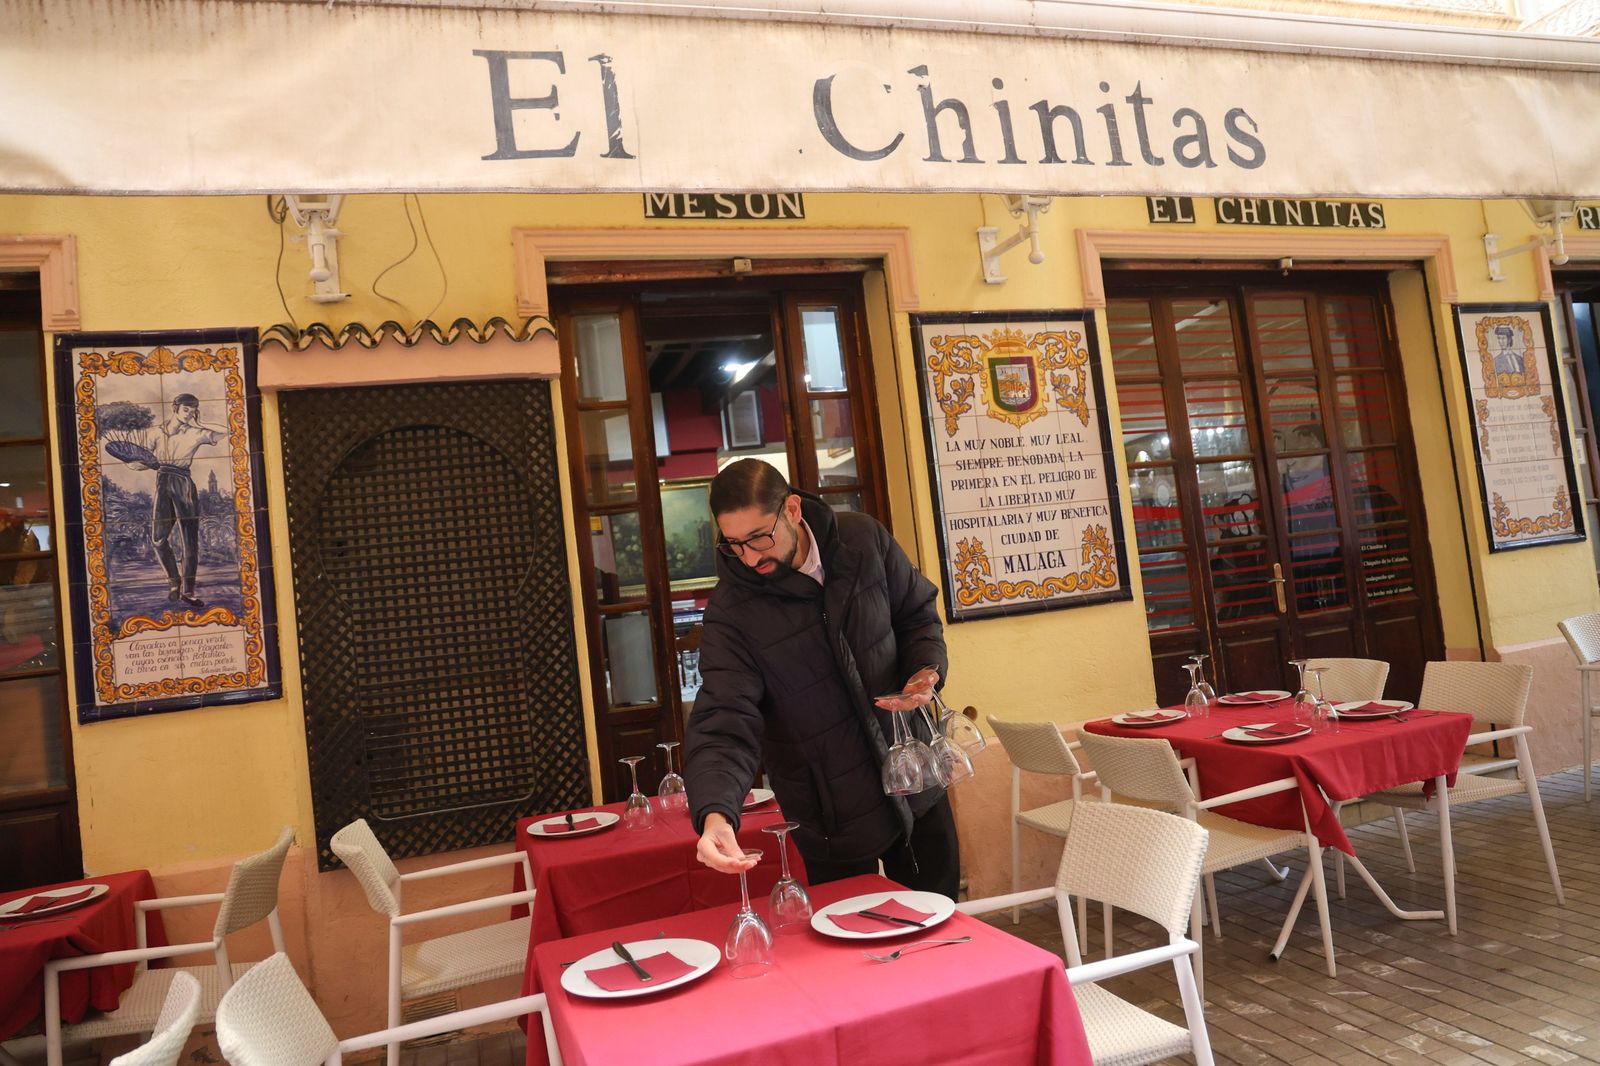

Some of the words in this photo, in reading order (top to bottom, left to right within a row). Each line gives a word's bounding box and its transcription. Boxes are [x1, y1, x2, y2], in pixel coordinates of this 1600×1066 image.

[472, 49, 636, 161] El
[812, 64, 1267, 169] Chinitas
[1150, 196, 1194, 223] EL
[1218, 197, 1384, 228] CHINITAS
[1580, 207, 1600, 229] R
[946, 441, 961, 452] LA
[964, 438, 986, 451] MUY
[1030, 434, 1051, 446] MUY
[955, 457, 1004, 471] SIEMPRE
[1069, 451, 1084, 462] LA
[951, 476, 999, 491] PRIMERA
[1003, 475, 1018, 487] EN
[1021, 474, 1035, 485] EL
[1039, 470, 1081, 484] PELIGRO
[1084, 469, 1098, 480] DE
[979, 497, 995, 508] LA
[998, 491, 1053, 507] LIBERTAD
[1056, 489, 1076, 501] MUY
[950, 513, 1024, 531] HOSPITALARIA
[1026, 512, 1033, 523] Y
[1036, 509, 1057, 522] MUY
[1061, 505, 1108, 520] BENEFICA
[1001, 531, 1042, 545] CIUDAD
[1046, 529, 1060, 541] DE
[1004, 551, 1067, 574] MALAGA
[129, 640, 166, 652] Clavadas
[143, 650, 154, 658] las
[125, 666, 133, 675] la
[132, 658, 154, 667] cuyas
